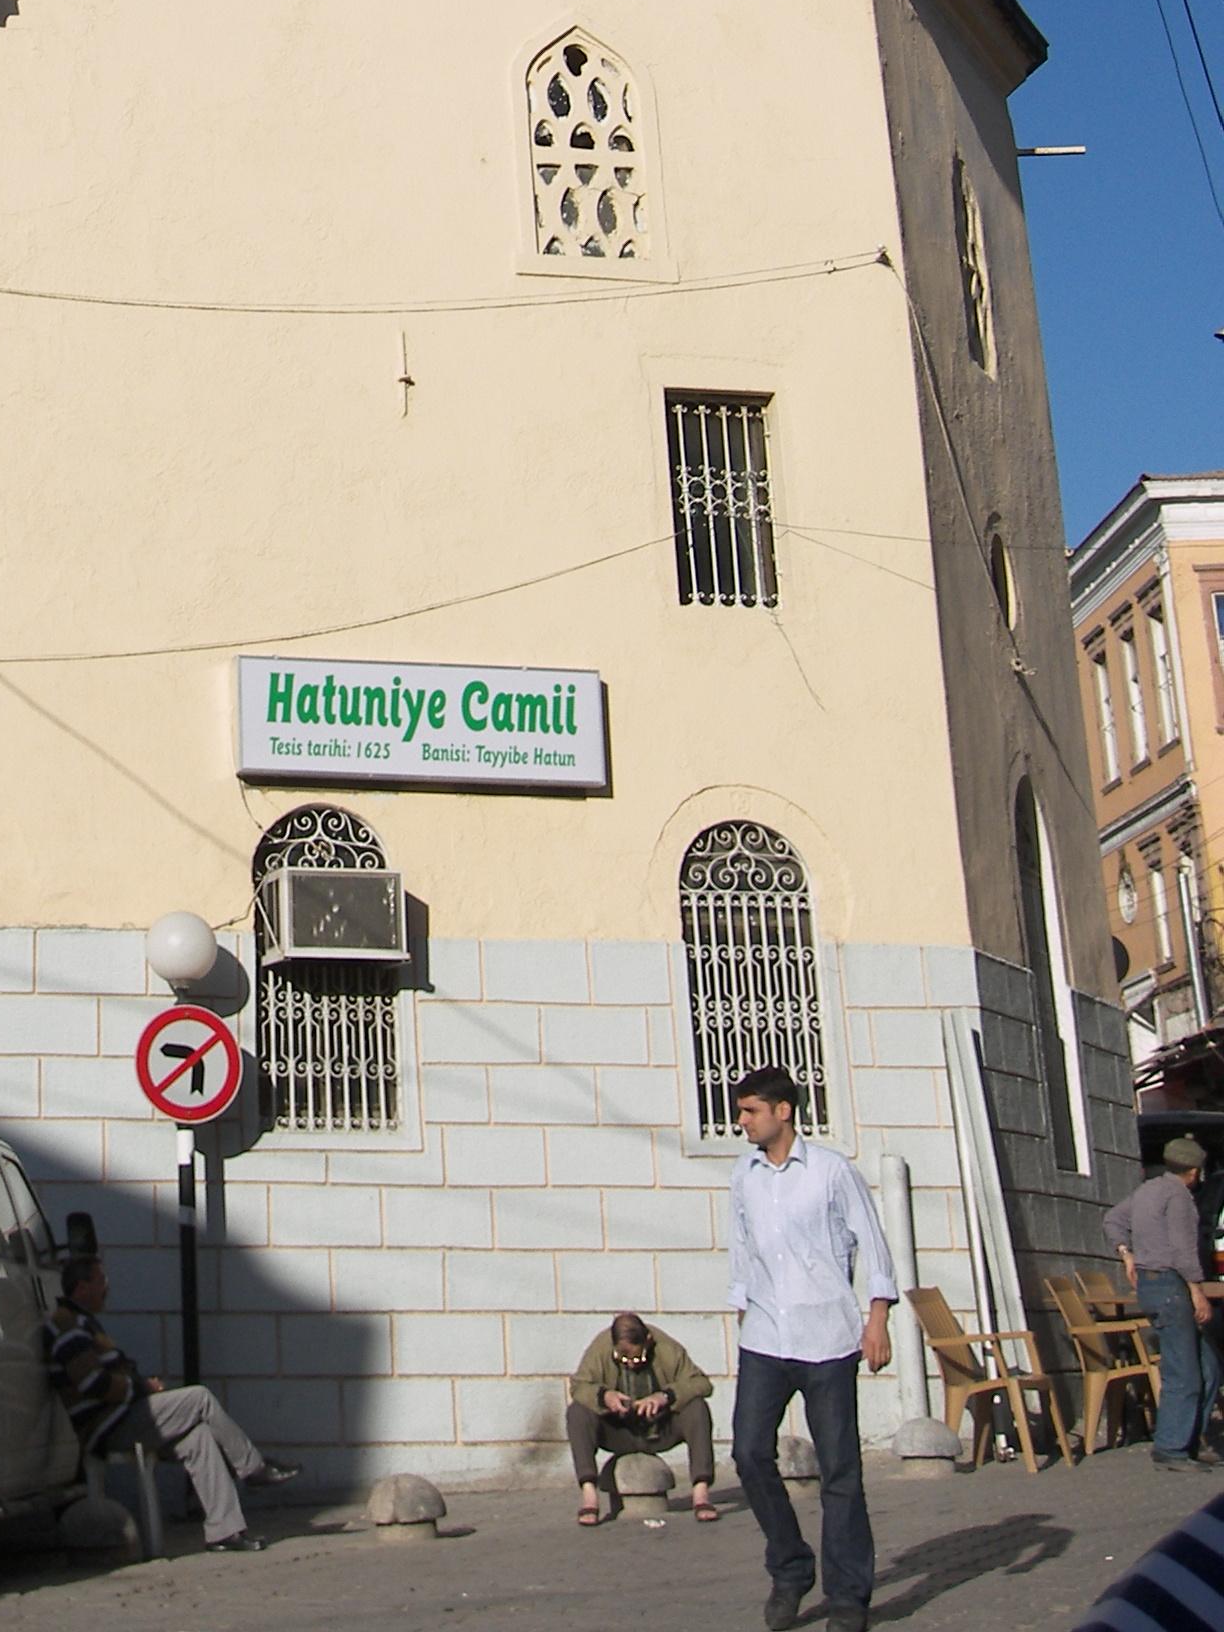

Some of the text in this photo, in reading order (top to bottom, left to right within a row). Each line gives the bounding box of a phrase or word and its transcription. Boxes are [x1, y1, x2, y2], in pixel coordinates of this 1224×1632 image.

[266, 671, 578, 743] Hatuniye Camii
[269, 736, 576, 768] Tesis tarihi: 1625 Banisi: Tayyibe Hatun
